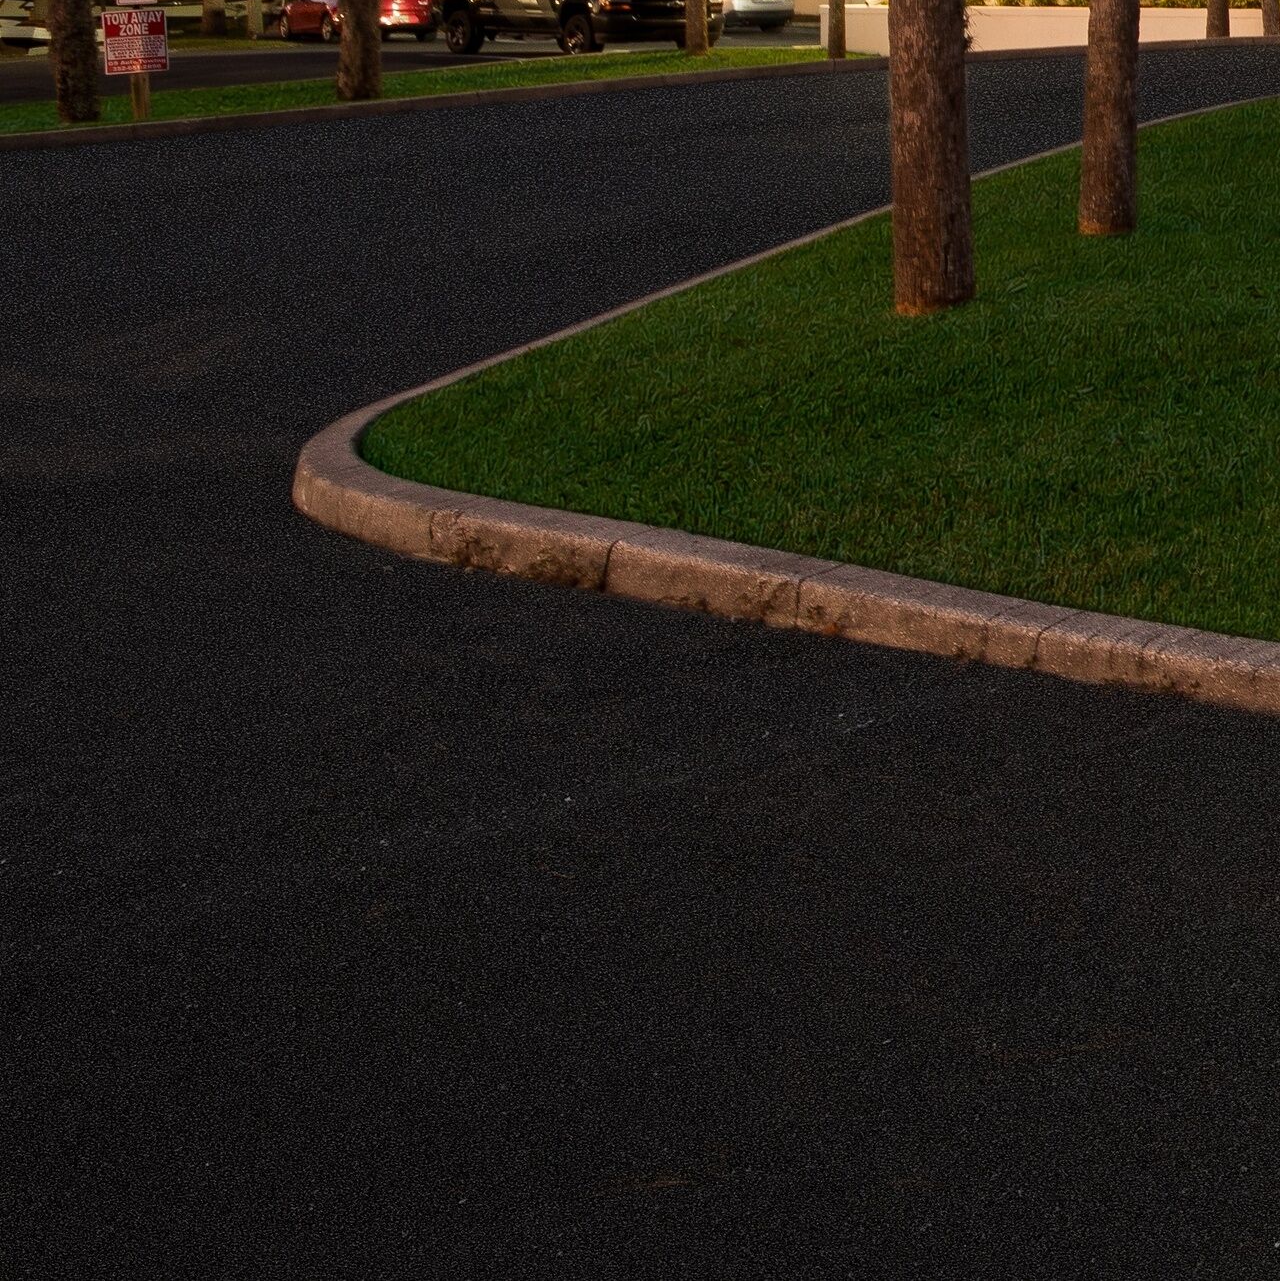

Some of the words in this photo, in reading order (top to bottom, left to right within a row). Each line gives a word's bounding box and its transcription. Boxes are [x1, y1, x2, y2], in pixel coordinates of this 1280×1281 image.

[105, 13, 129, 26] TOW
[130, 11, 163, 24] AWAY
[119, 23, 150, 36] ZONE
